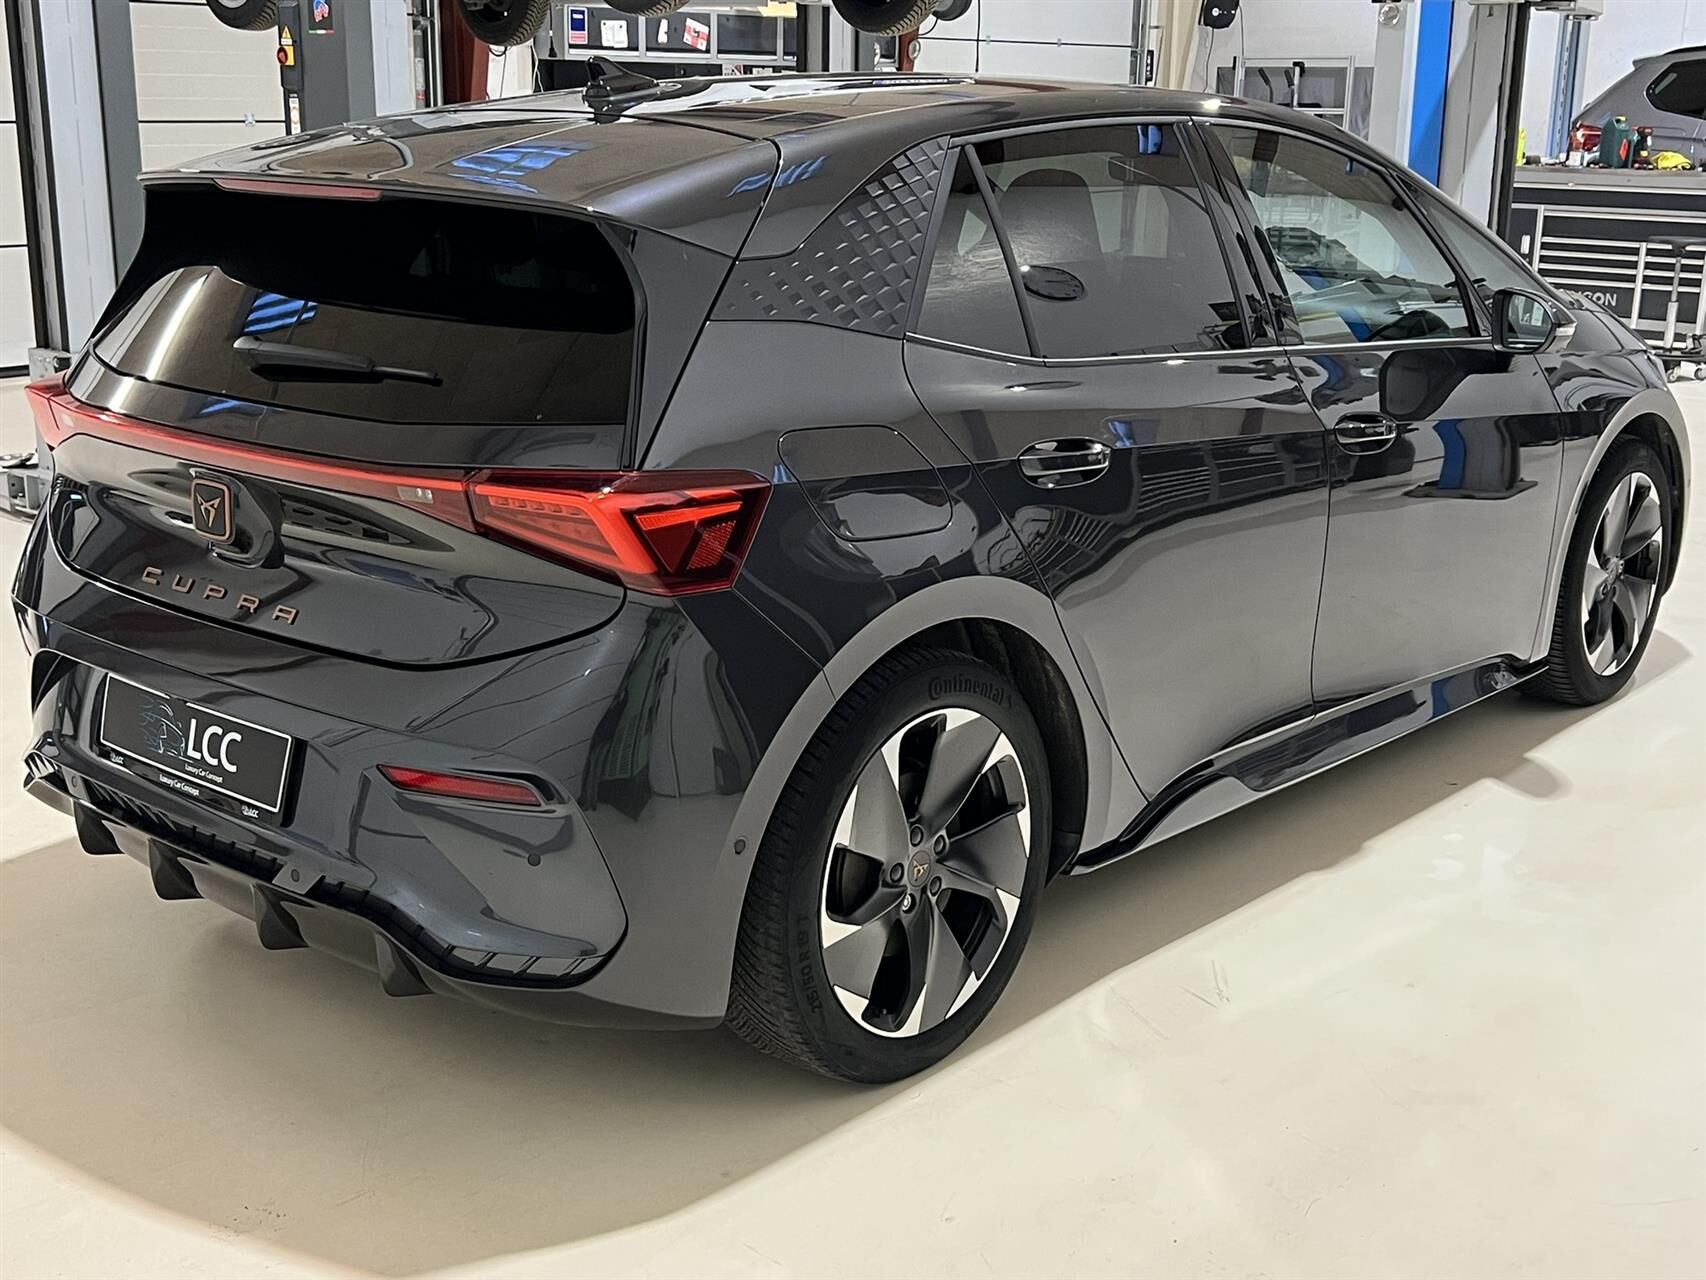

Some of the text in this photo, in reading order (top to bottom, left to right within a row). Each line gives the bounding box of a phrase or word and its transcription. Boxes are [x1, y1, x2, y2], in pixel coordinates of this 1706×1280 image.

[142, 566, 299, 625] CUPRA
[928, 673, 1005, 706] Continental
[187, 718, 242, 773] LCC
[159, 773, 200, 796] Luxury Car Concept
[184, 763, 223, 784] Luxury Car Concept
